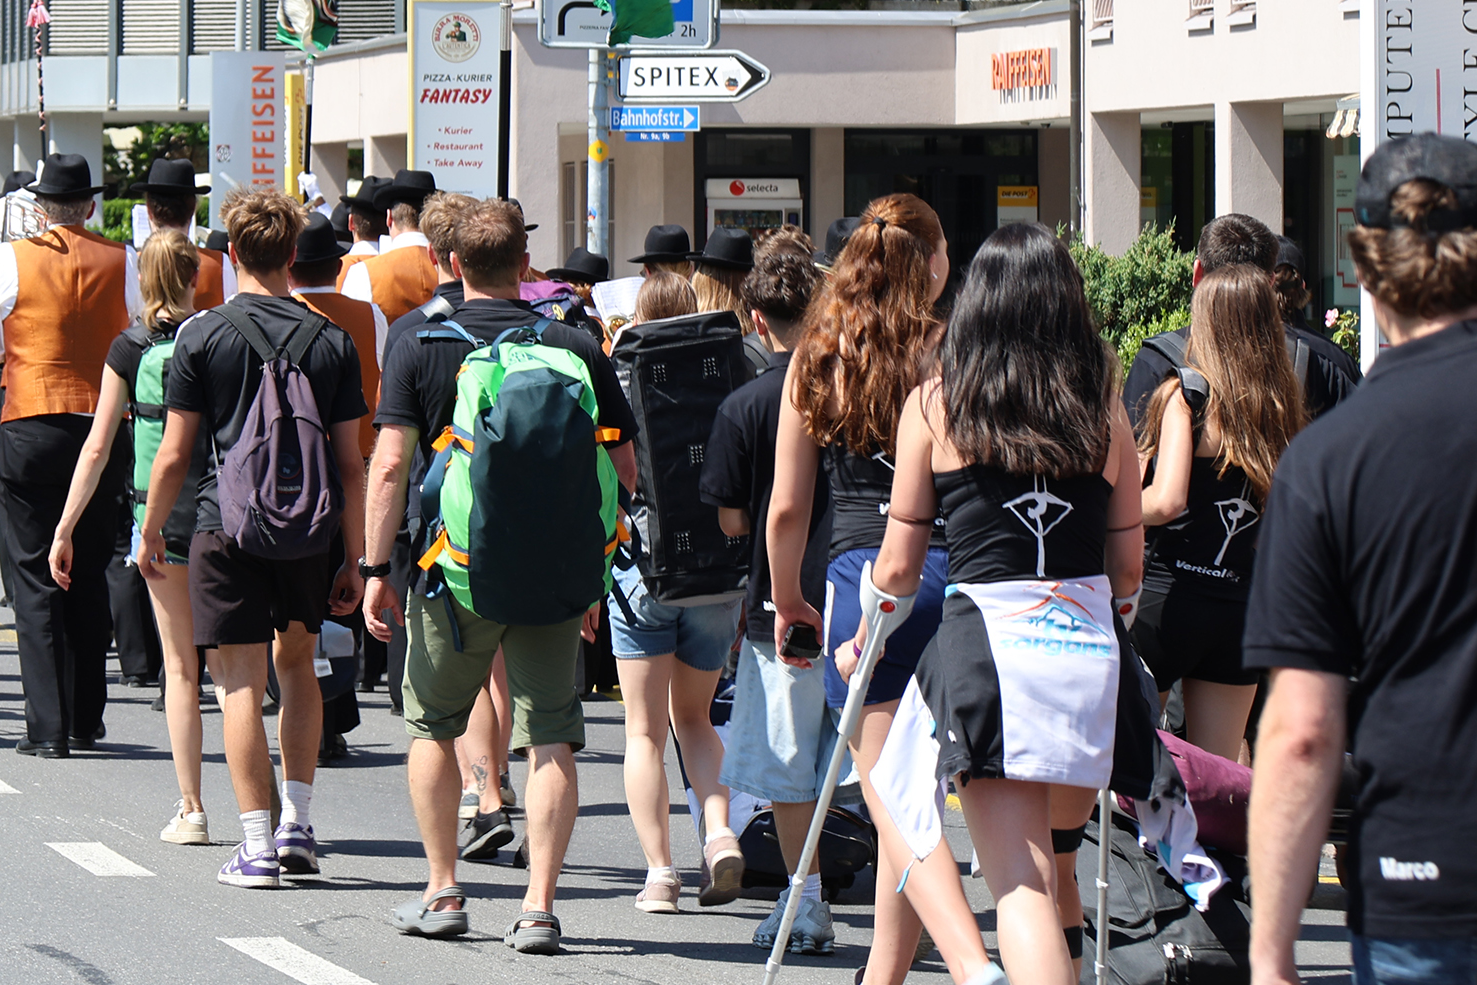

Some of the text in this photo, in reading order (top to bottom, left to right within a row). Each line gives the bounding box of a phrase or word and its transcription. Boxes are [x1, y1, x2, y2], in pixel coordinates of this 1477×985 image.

[680, 24, 696, 37] 2h
[991, 47, 1051, 90] RAIFFEISEN
[633, 67, 719, 87] SPITEX
[420, 88, 492, 104] FANTASY
[612, 109, 683, 126] Bahnhofstr.
[444, 127, 473, 135] Kurier
[433, 142, 483, 150] Restaurant
[434, 159, 483, 169] Take Away
[746, 184, 778, 193] selecta
[1175, 559, 1227, 578] Vertical
[1379, 857, 1440, 880] Marco
